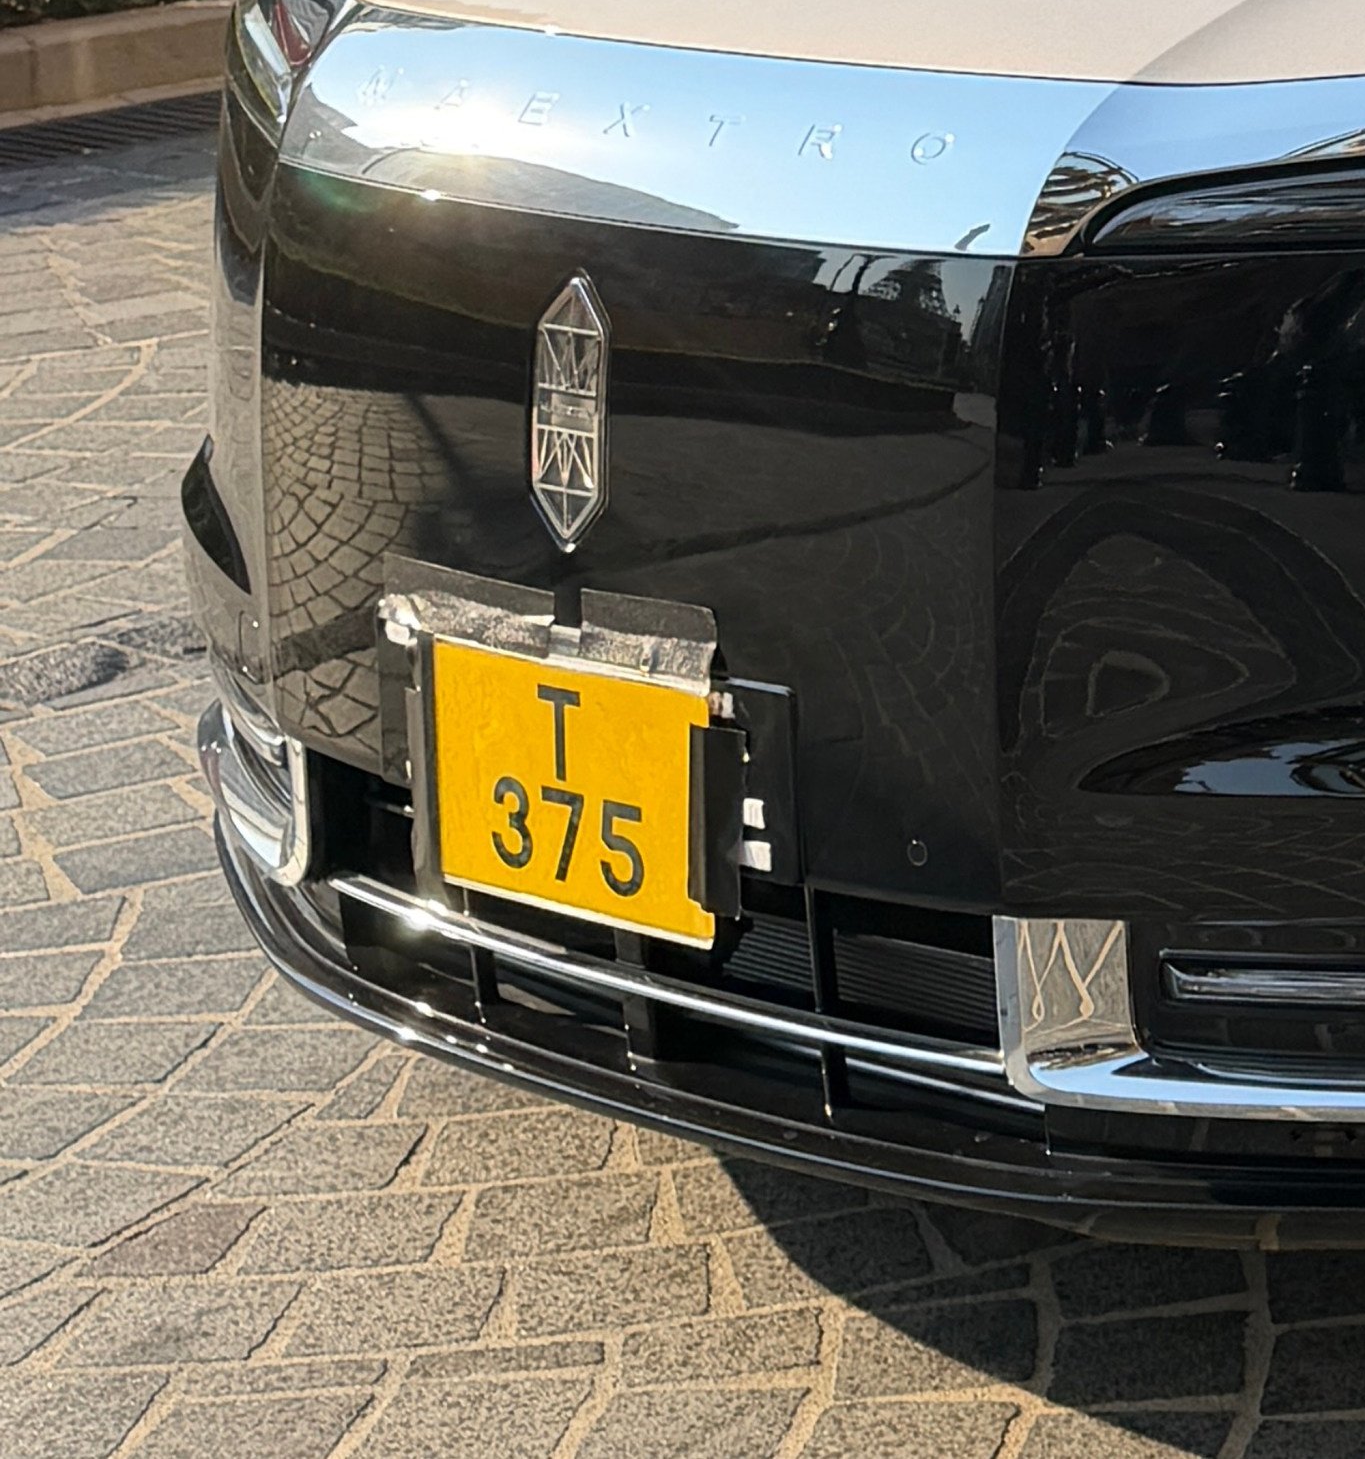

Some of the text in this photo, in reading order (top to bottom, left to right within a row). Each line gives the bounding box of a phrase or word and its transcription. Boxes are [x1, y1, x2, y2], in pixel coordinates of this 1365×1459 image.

[356, 64, 957, 166] MAEXTRO
[536, 683, 581, 782] T
[491, 776, 645, 898] 375
